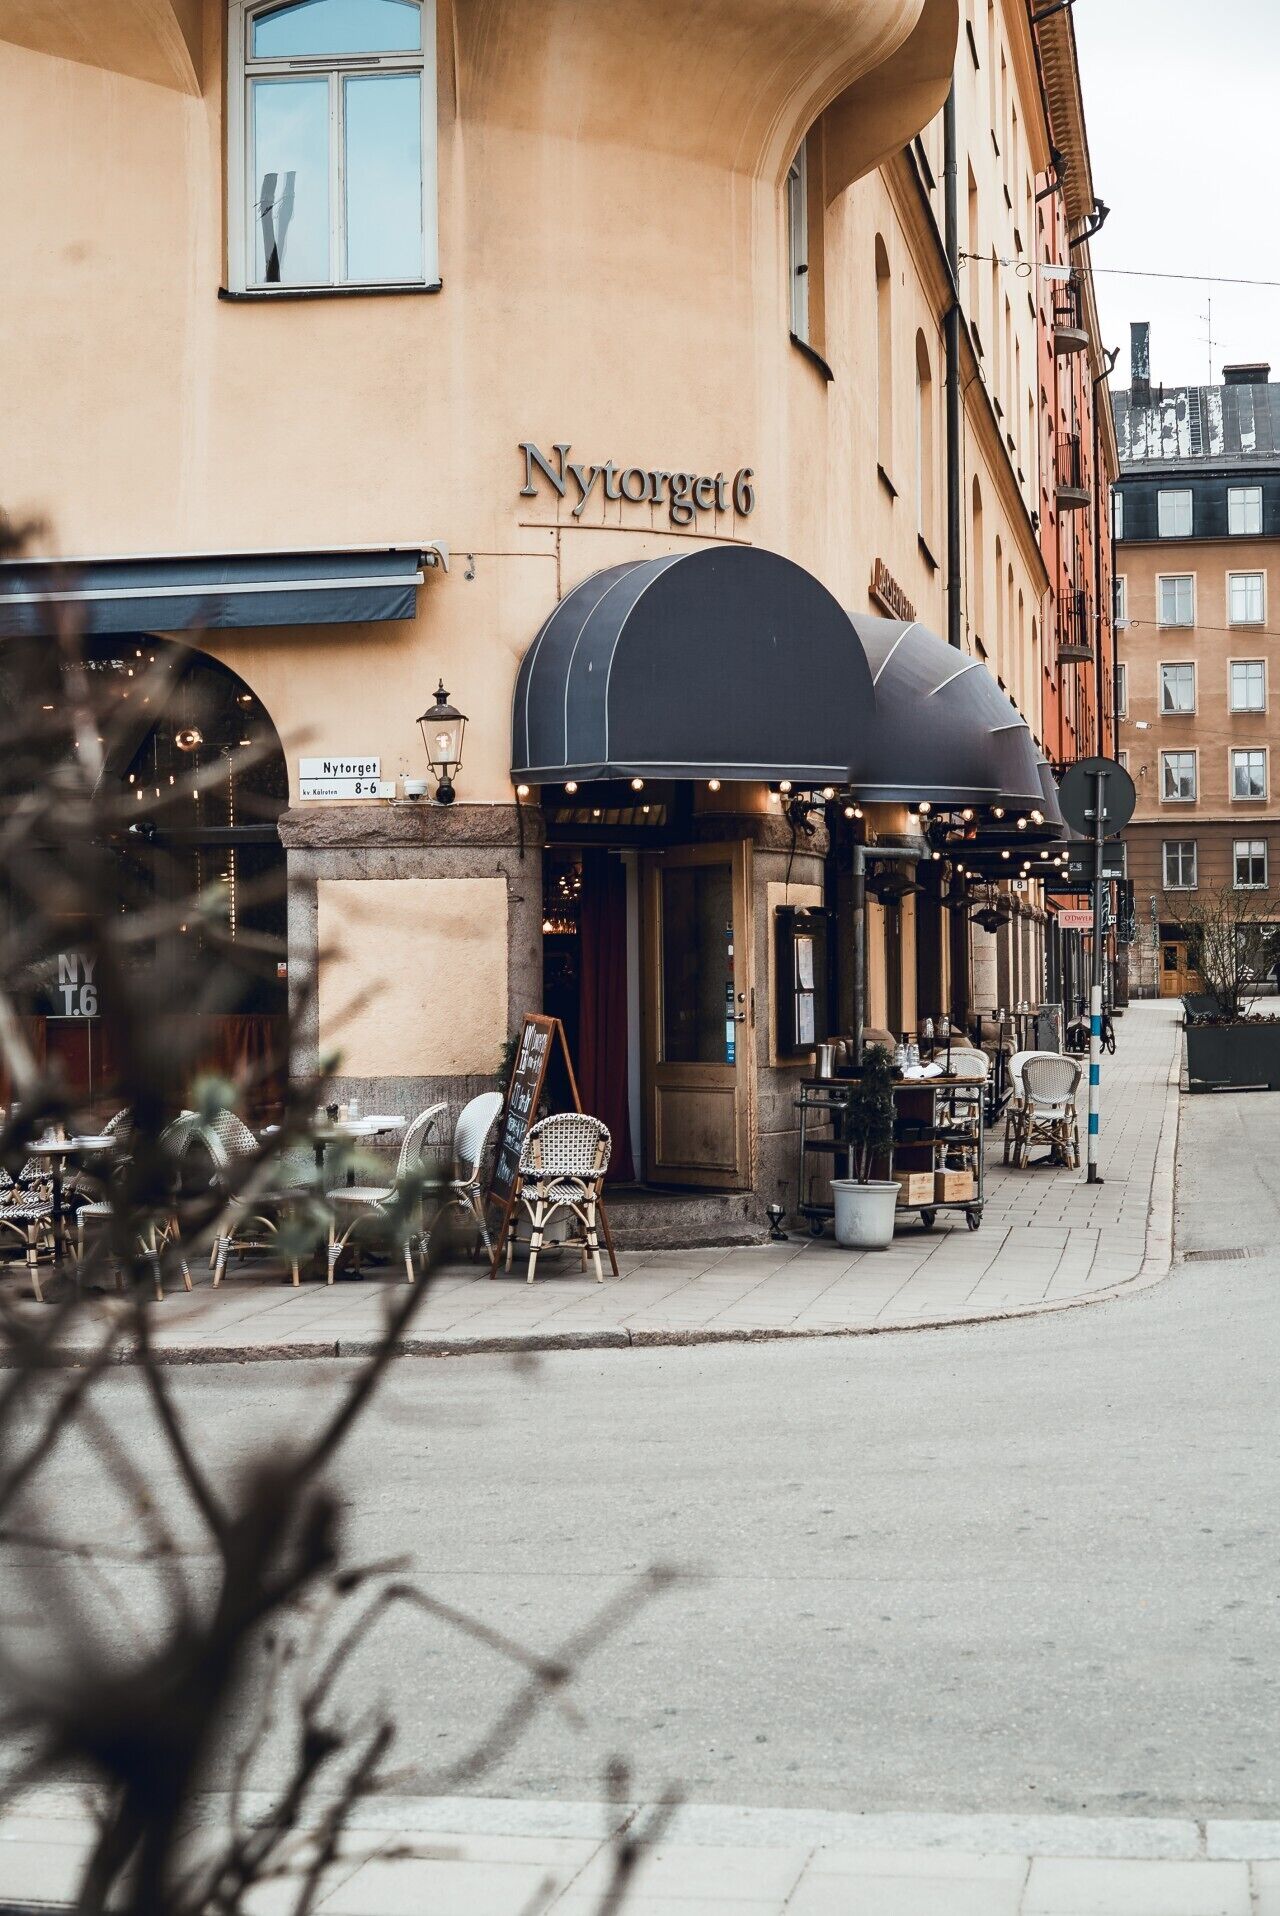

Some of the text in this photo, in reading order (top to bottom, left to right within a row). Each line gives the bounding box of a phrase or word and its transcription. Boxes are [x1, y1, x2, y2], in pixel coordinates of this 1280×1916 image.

[518, 442, 755, 525] Nytorget 6
[323, 762, 377, 776] Nytorget
[355, 782, 377, 794] 8-6
[1017, 881, 1023, 889] 8
[59, 954, 98, 983] NY
[59, 984, 98, 1016] T.6
